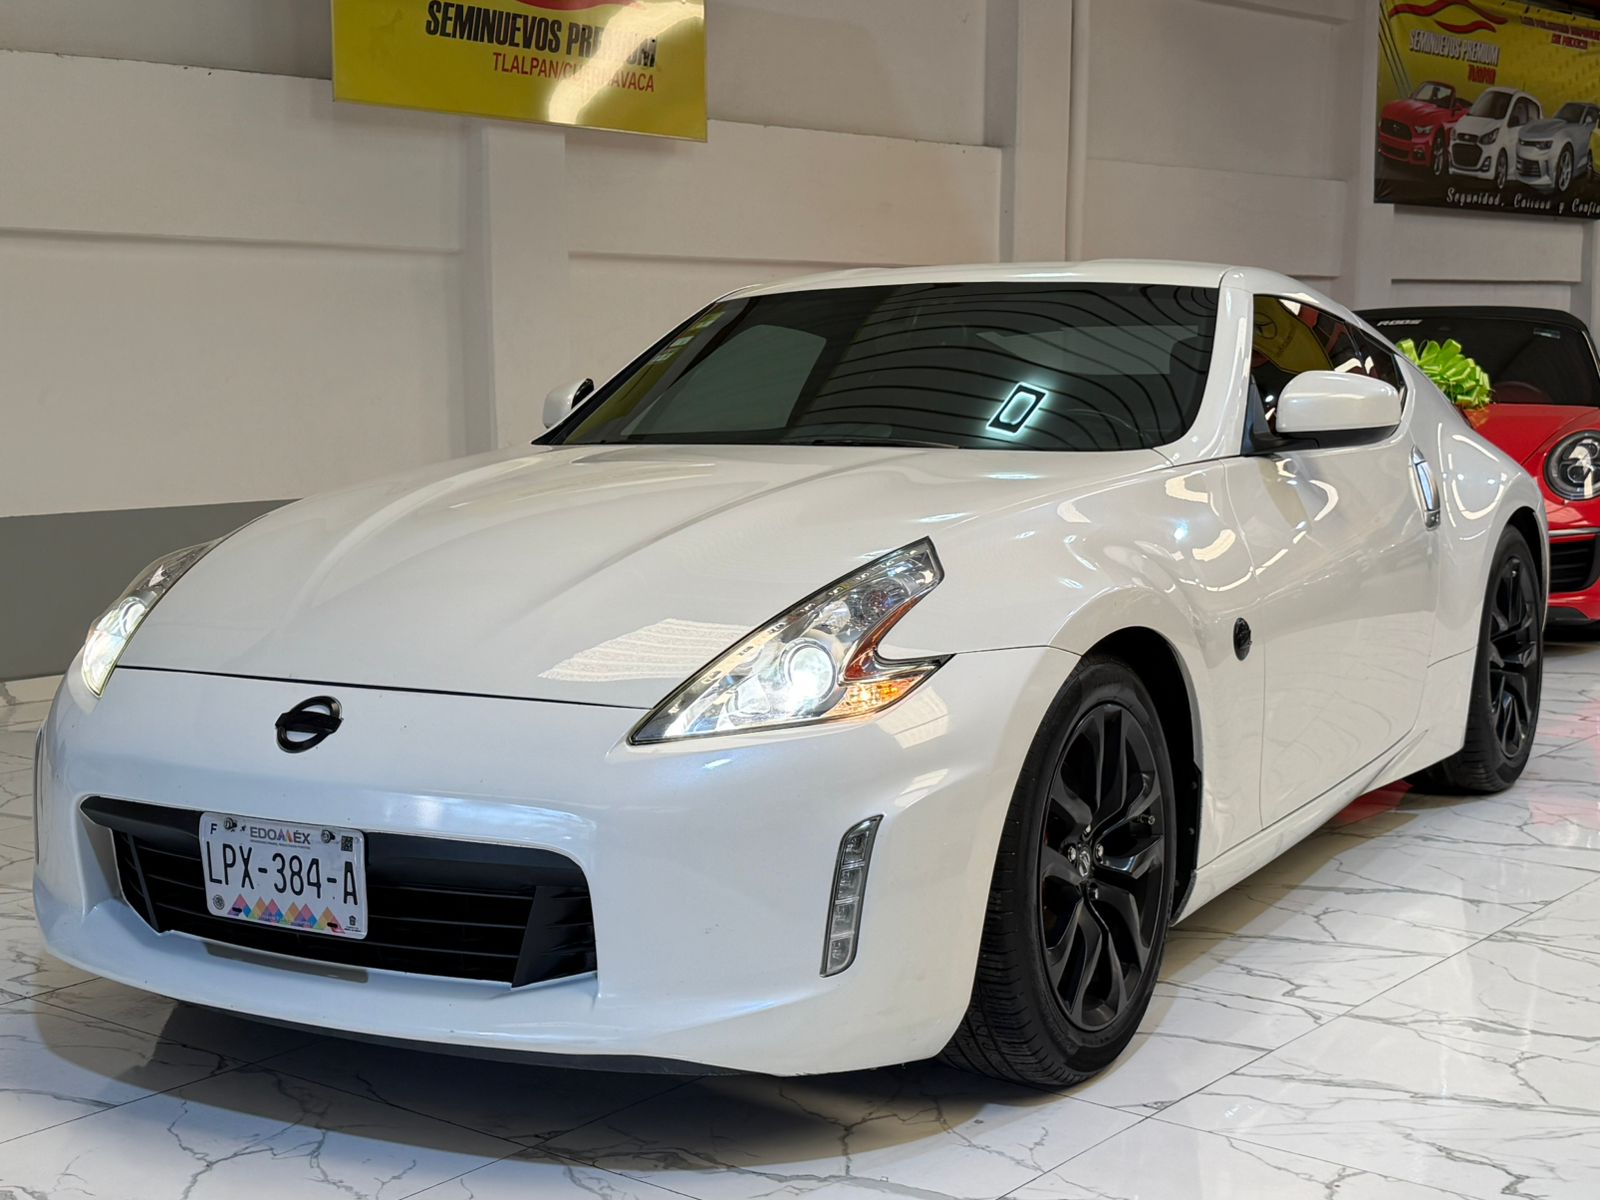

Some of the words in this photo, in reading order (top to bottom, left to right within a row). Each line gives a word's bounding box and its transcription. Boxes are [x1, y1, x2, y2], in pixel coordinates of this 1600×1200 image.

[426, 0, 561, 53] SEMINUEVOS
[566, 22, 657, 67] PREUM
[493, 52, 655, 93] TLALPAN/CUAVACA
[210, 823, 218, 835] F
[206, 841, 359, 905] LPX-384-A
